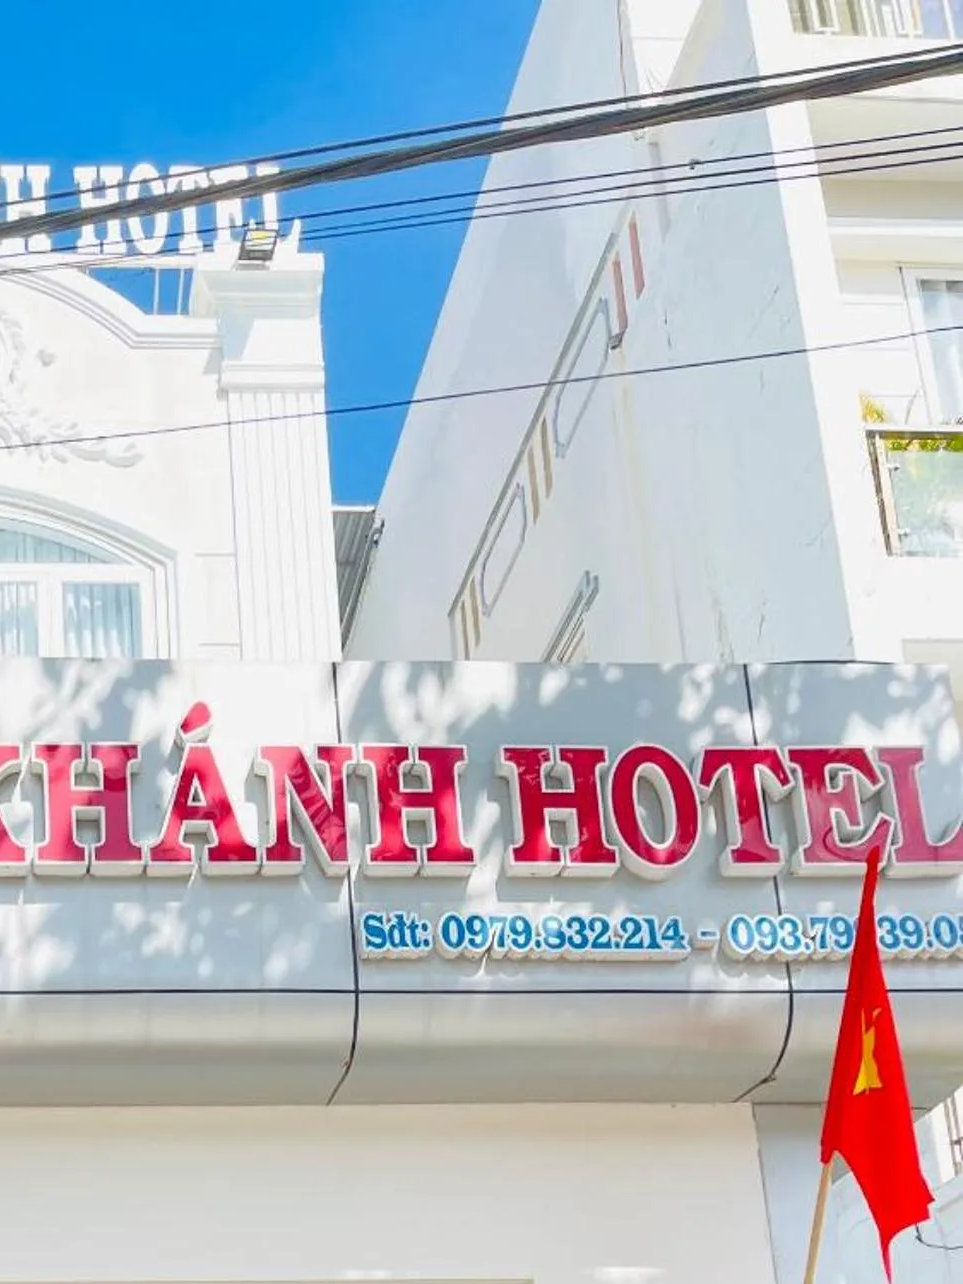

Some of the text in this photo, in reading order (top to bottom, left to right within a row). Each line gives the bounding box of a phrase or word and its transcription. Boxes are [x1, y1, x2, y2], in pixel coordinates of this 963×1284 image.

[500, 743, 963, 870] HOTEL
[362, 912, 431, 950] Sđt:
[440, 914, 688, 950] 0979.832.214
[729, 914, 963, 951] 093.7939.0
